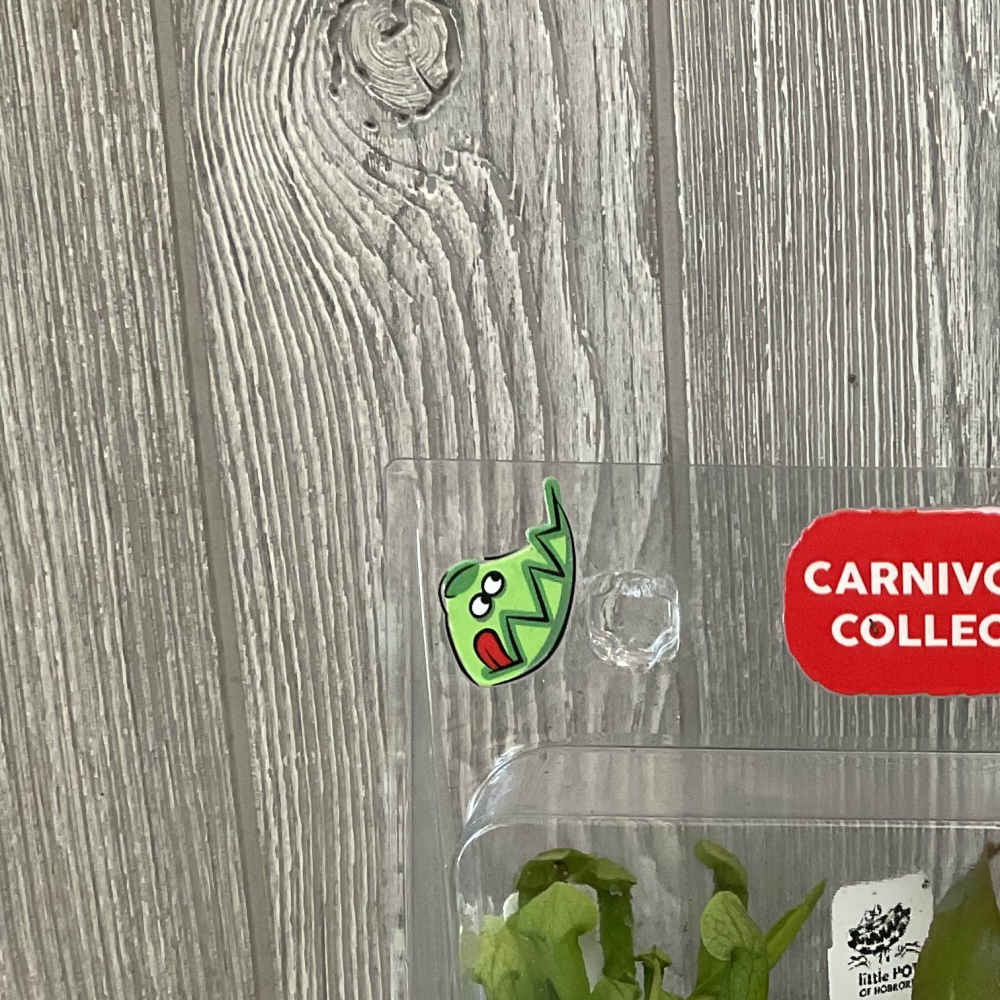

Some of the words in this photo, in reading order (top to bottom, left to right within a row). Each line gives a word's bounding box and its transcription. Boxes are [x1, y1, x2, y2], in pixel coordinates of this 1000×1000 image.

[858, 967, 890, 986] little
[892, 962, 917, 980] PO
[858, 986, 872, 998] OF
